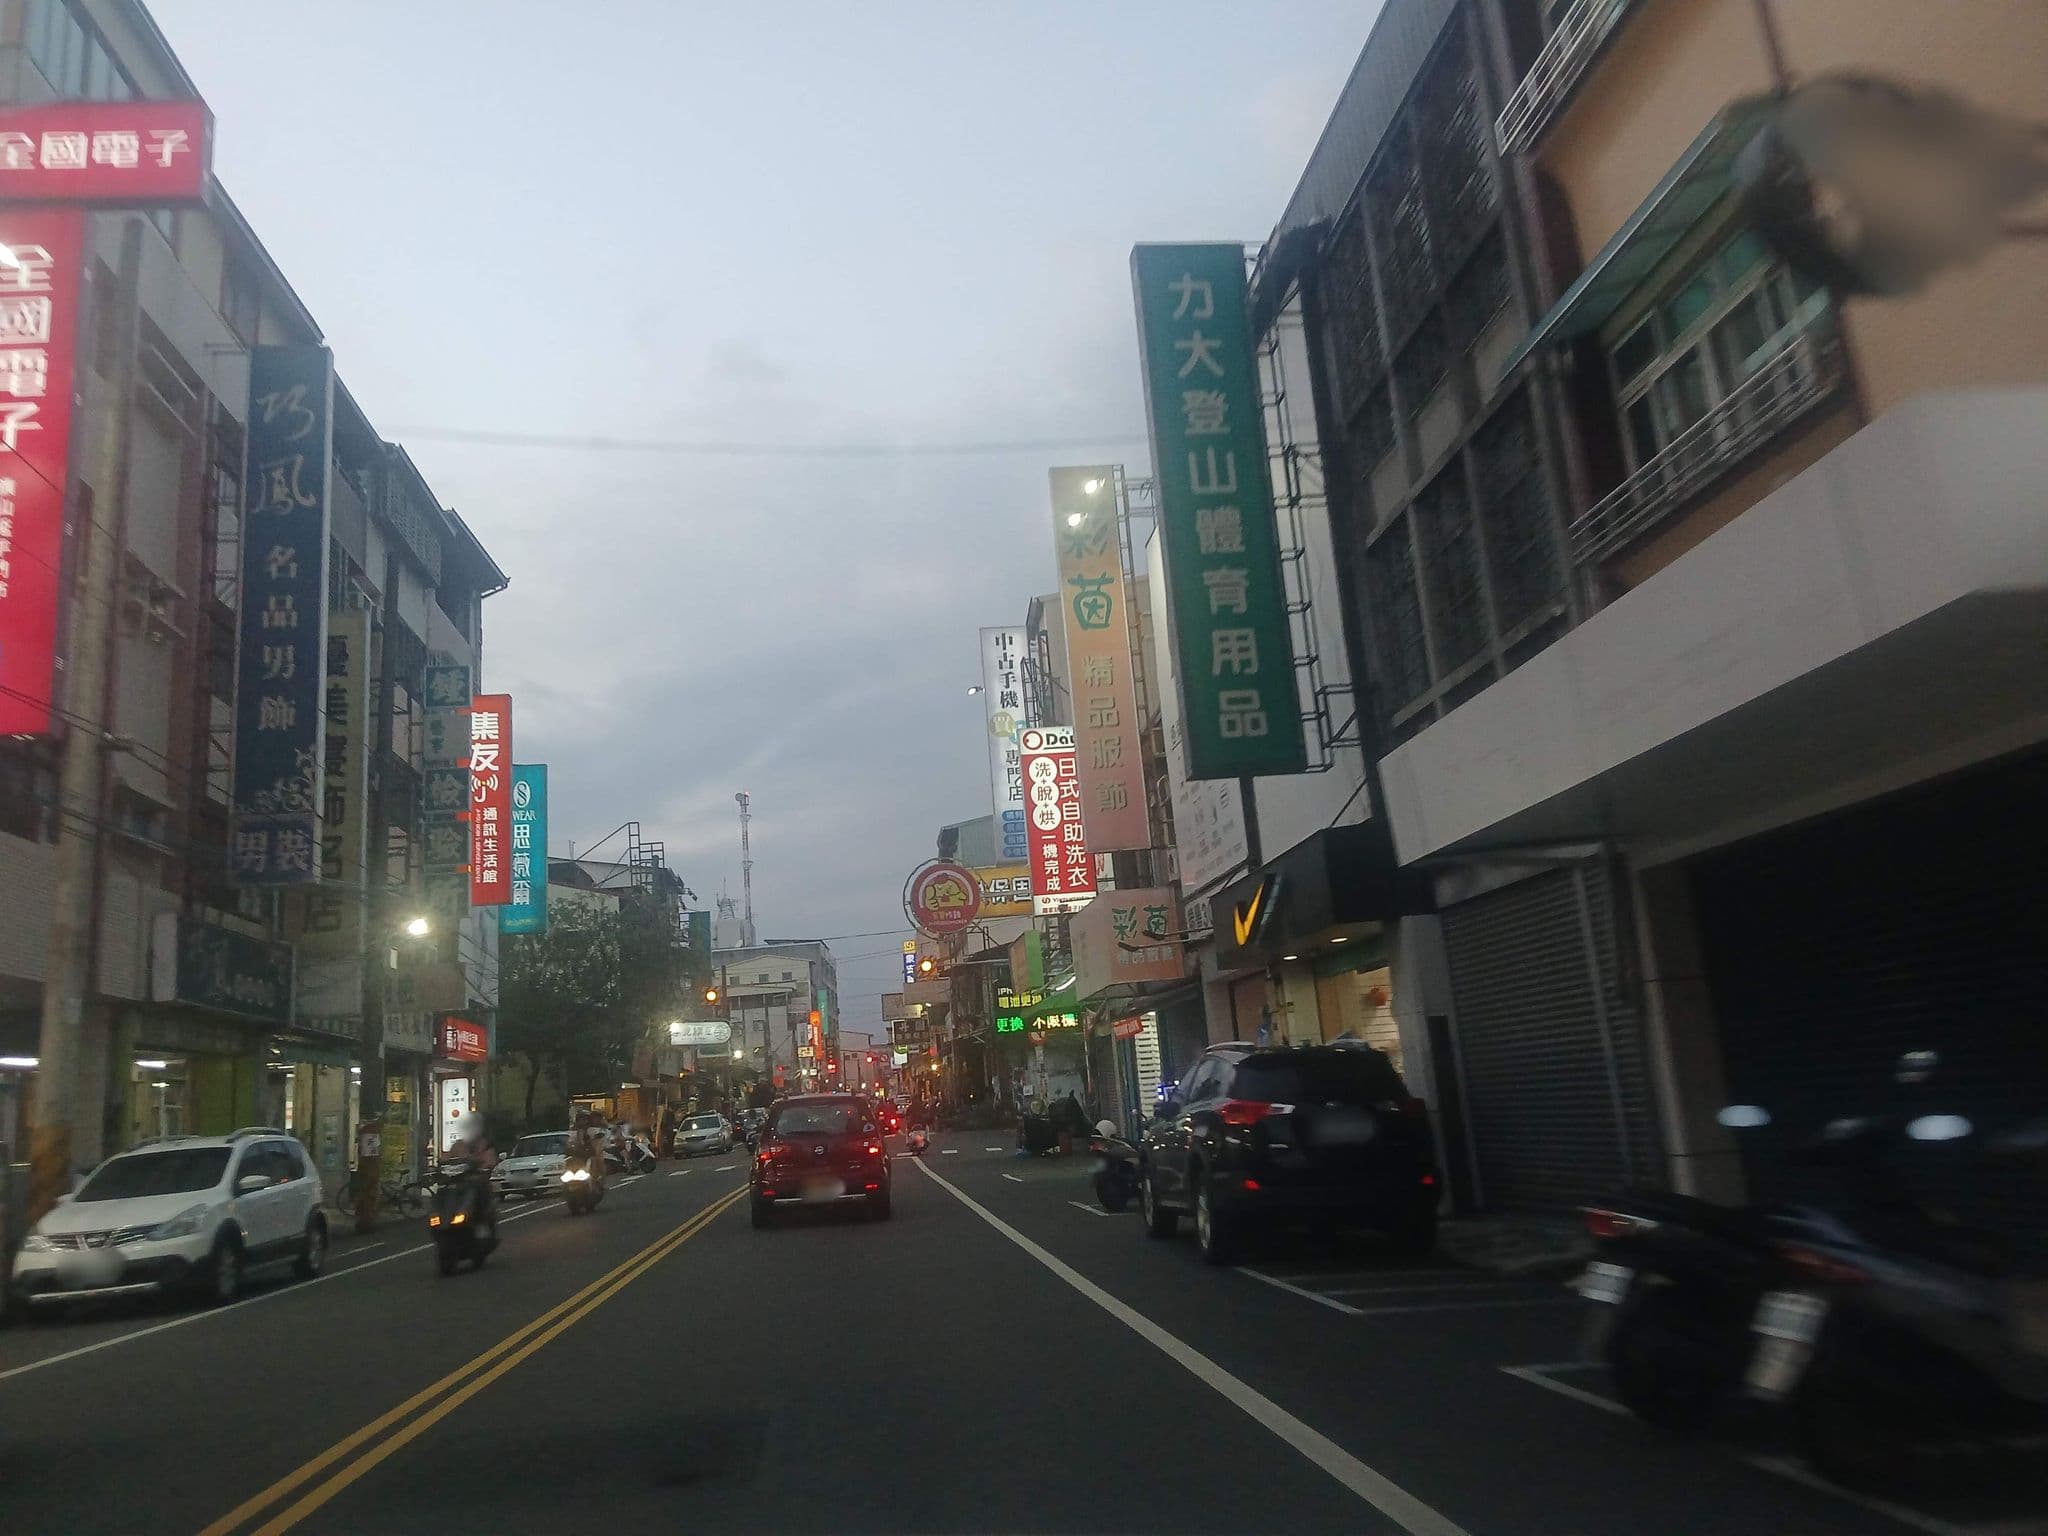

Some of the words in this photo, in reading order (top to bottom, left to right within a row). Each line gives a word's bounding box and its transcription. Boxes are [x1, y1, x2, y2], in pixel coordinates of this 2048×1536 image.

[0, 129, 190, 171] 全國電子
[1167, 272, 1269, 739] 力大登山體育用品
[995, 632, 1020, 709] 中古手機
[469, 711, 500, 772] 集友
[1081, 655, 1129, 813] 精品服飾
[482, 807, 498, 884] 通訊生活館
[1058, 757, 1089, 888] 日式自助洗衣
[512, 823, 531, 906] 思薇爾
[1041, 834, 1062, 892] 一機完成
[1112, 904, 1170, 942] 彩茵
[1032, 1013, 1079, 1030] 不限機
